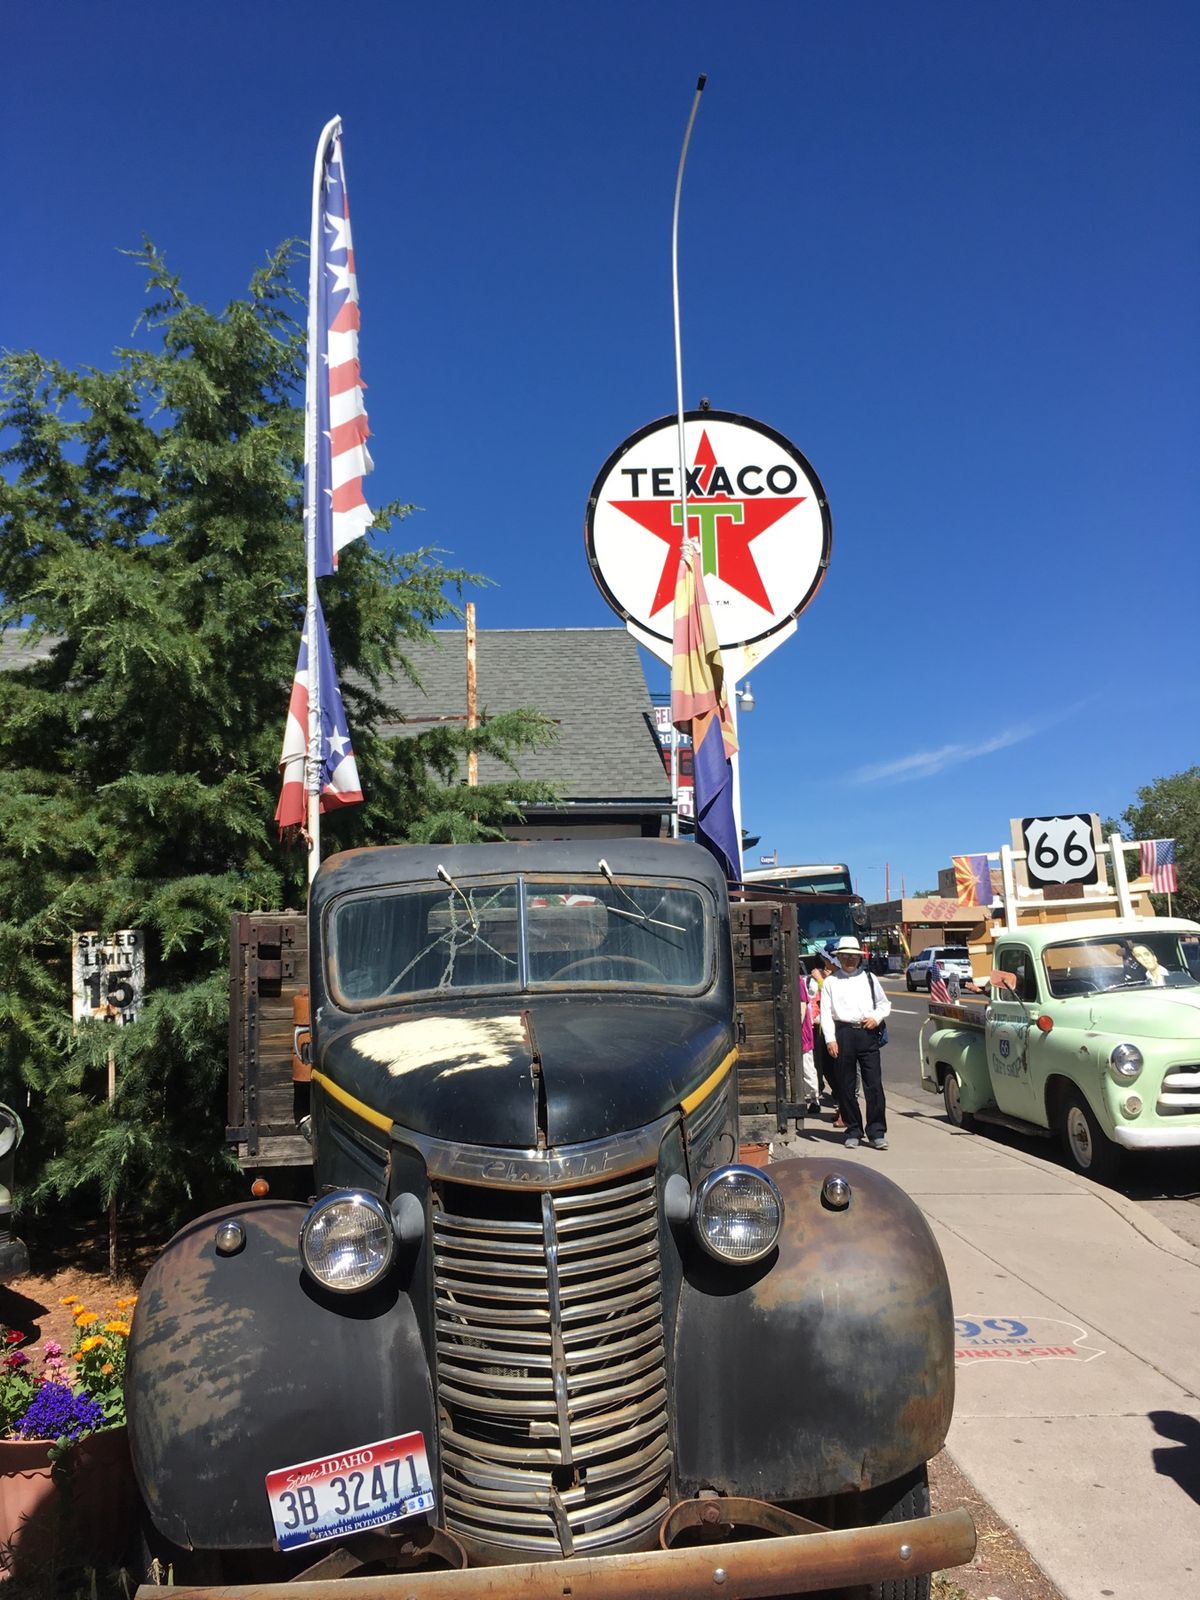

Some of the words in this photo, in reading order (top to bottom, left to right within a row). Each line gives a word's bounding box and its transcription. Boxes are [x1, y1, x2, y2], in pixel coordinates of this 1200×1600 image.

[621, 465, 797, 497] TEXACO
[659, 733, 693, 745] ROUT
[1035, 830, 1088, 868] 66
[79, 934, 138, 948] SPEED
[84, 952, 133, 966] LIMIT
[84, 971, 134, 1008] 15
[285, 1467, 323, 1490] Scenic
[320, 1450, 374, 1475] IDAHO
[279, 1485, 319, 1530] 3B
[329, 1453, 422, 1516] 32471
[316, 1523, 353, 1539] FAMOUS
[354, 1510, 398, 1531] POTATOES
